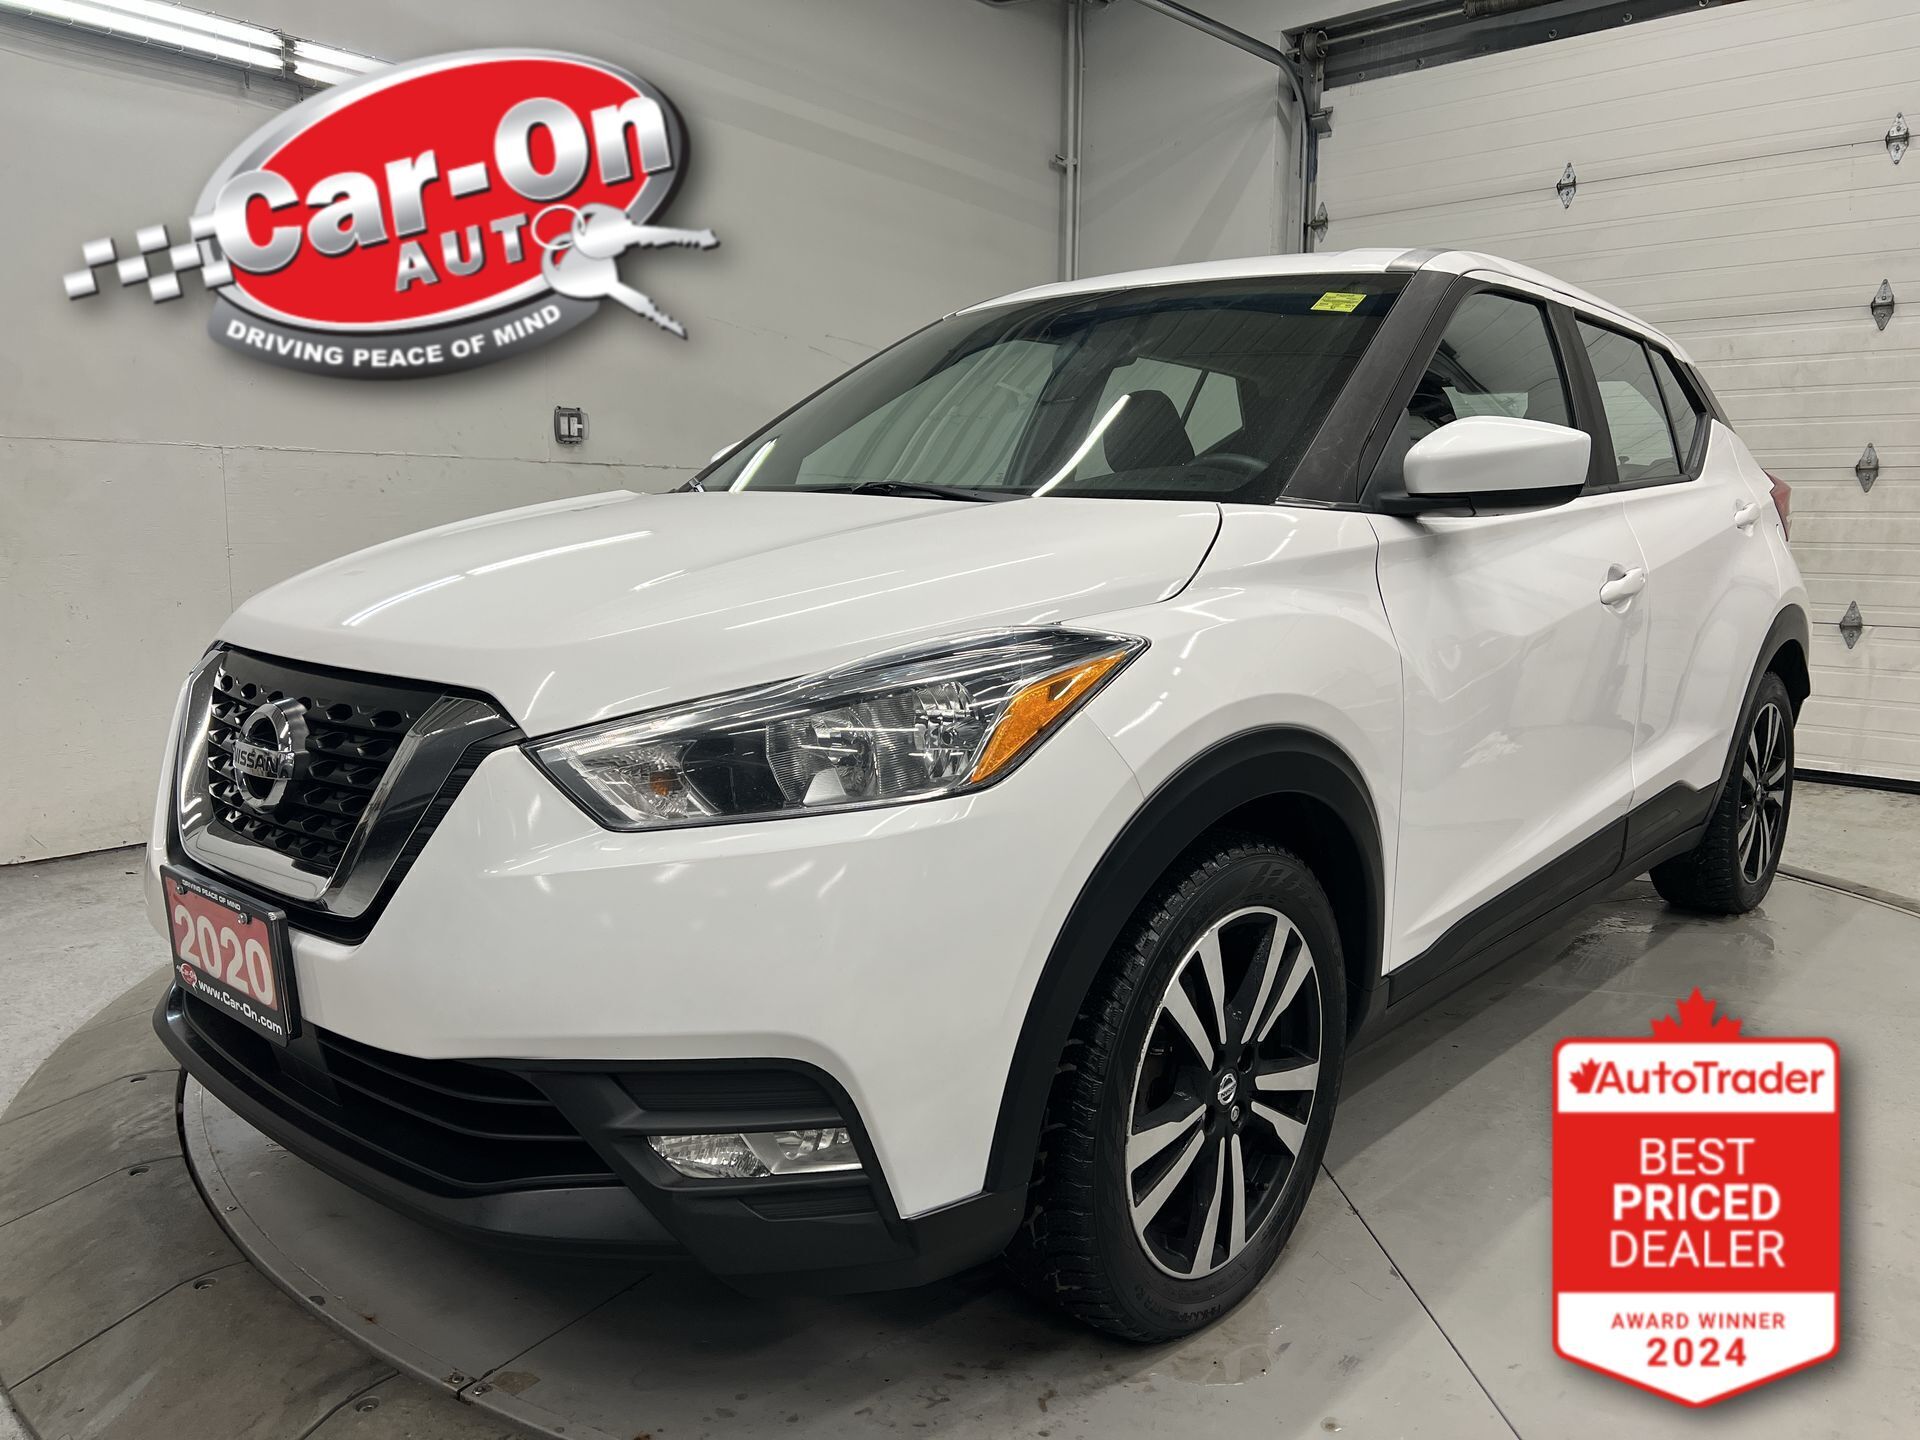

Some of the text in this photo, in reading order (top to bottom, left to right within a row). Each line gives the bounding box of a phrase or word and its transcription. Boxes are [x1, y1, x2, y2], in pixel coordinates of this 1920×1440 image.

[226, 899, 241, 911] MIND
[174, 904, 273, 1006] 2020
[198, 980, 283, 1036] www.Car-On.com
